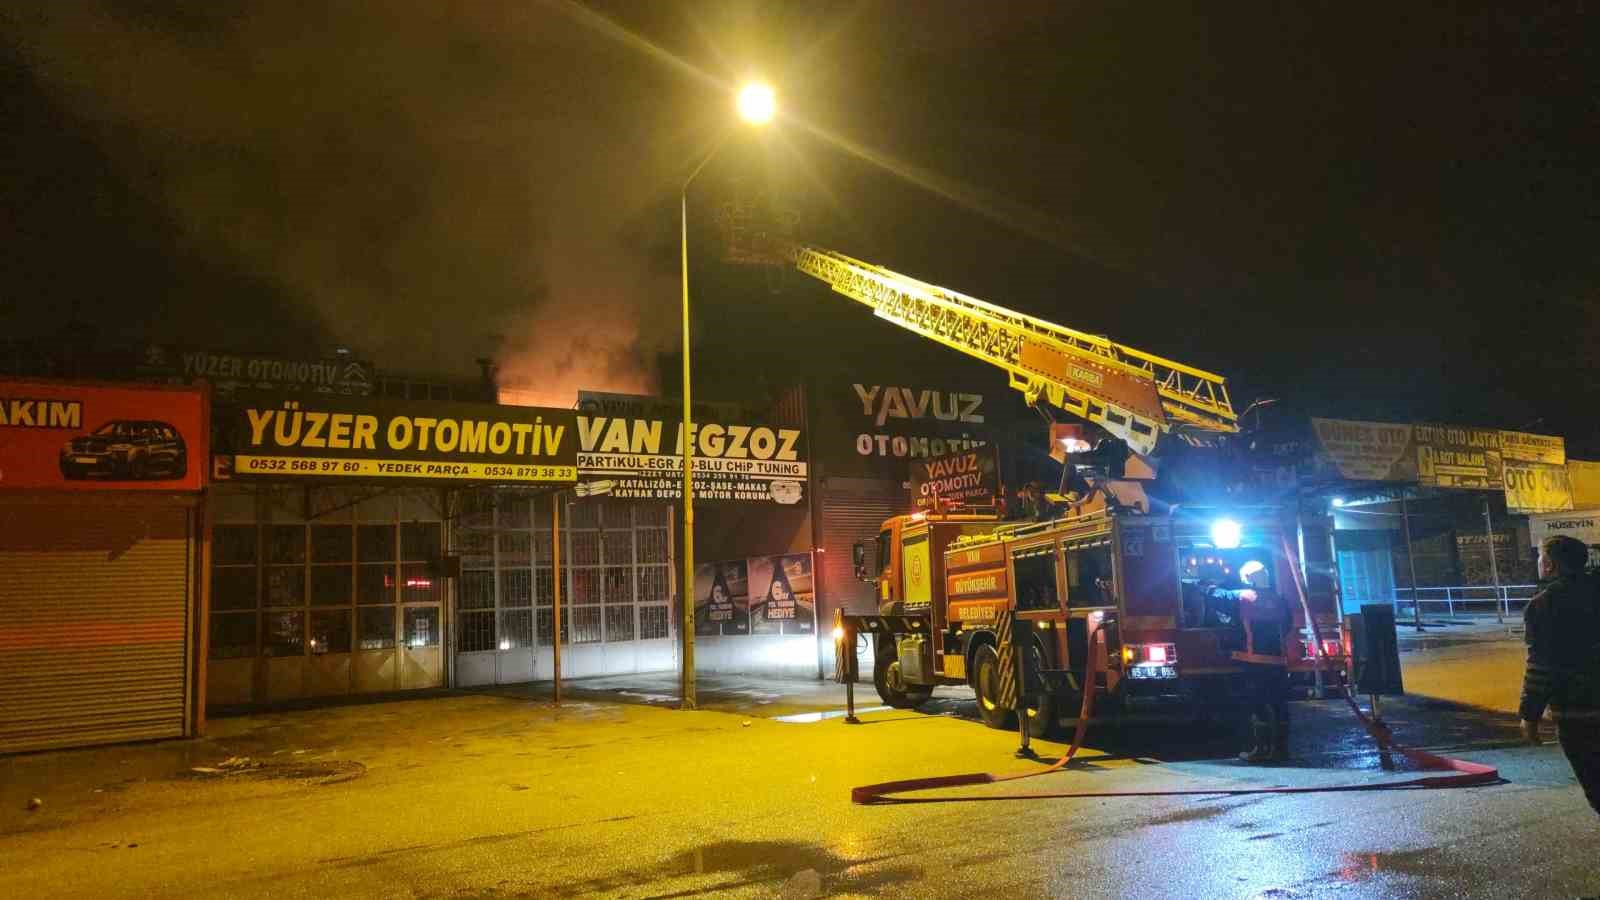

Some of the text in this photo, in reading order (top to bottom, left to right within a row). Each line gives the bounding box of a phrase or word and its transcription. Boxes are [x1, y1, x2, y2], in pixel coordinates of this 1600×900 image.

[852, 384, 986, 426] YAVUZ
[247, 401, 565, 456] YÜZER OTOMOTİV
[577, 416, 801, 461] VAN EGZOZ
[249, 459, 287, 471] 0532
[291, 460, 318, 472] 568
[321, 461, 340, 472] 97
[377, 463, 422, 474] YEDEK
[426, 465, 468, 477] PARÇA
[925, 453, 977, 480] YAVUZ
[1504, 468, 1537, 492] OTO
[657, 489, 682, 499] DEPO
[700, 490, 731, 500] MOTOR
